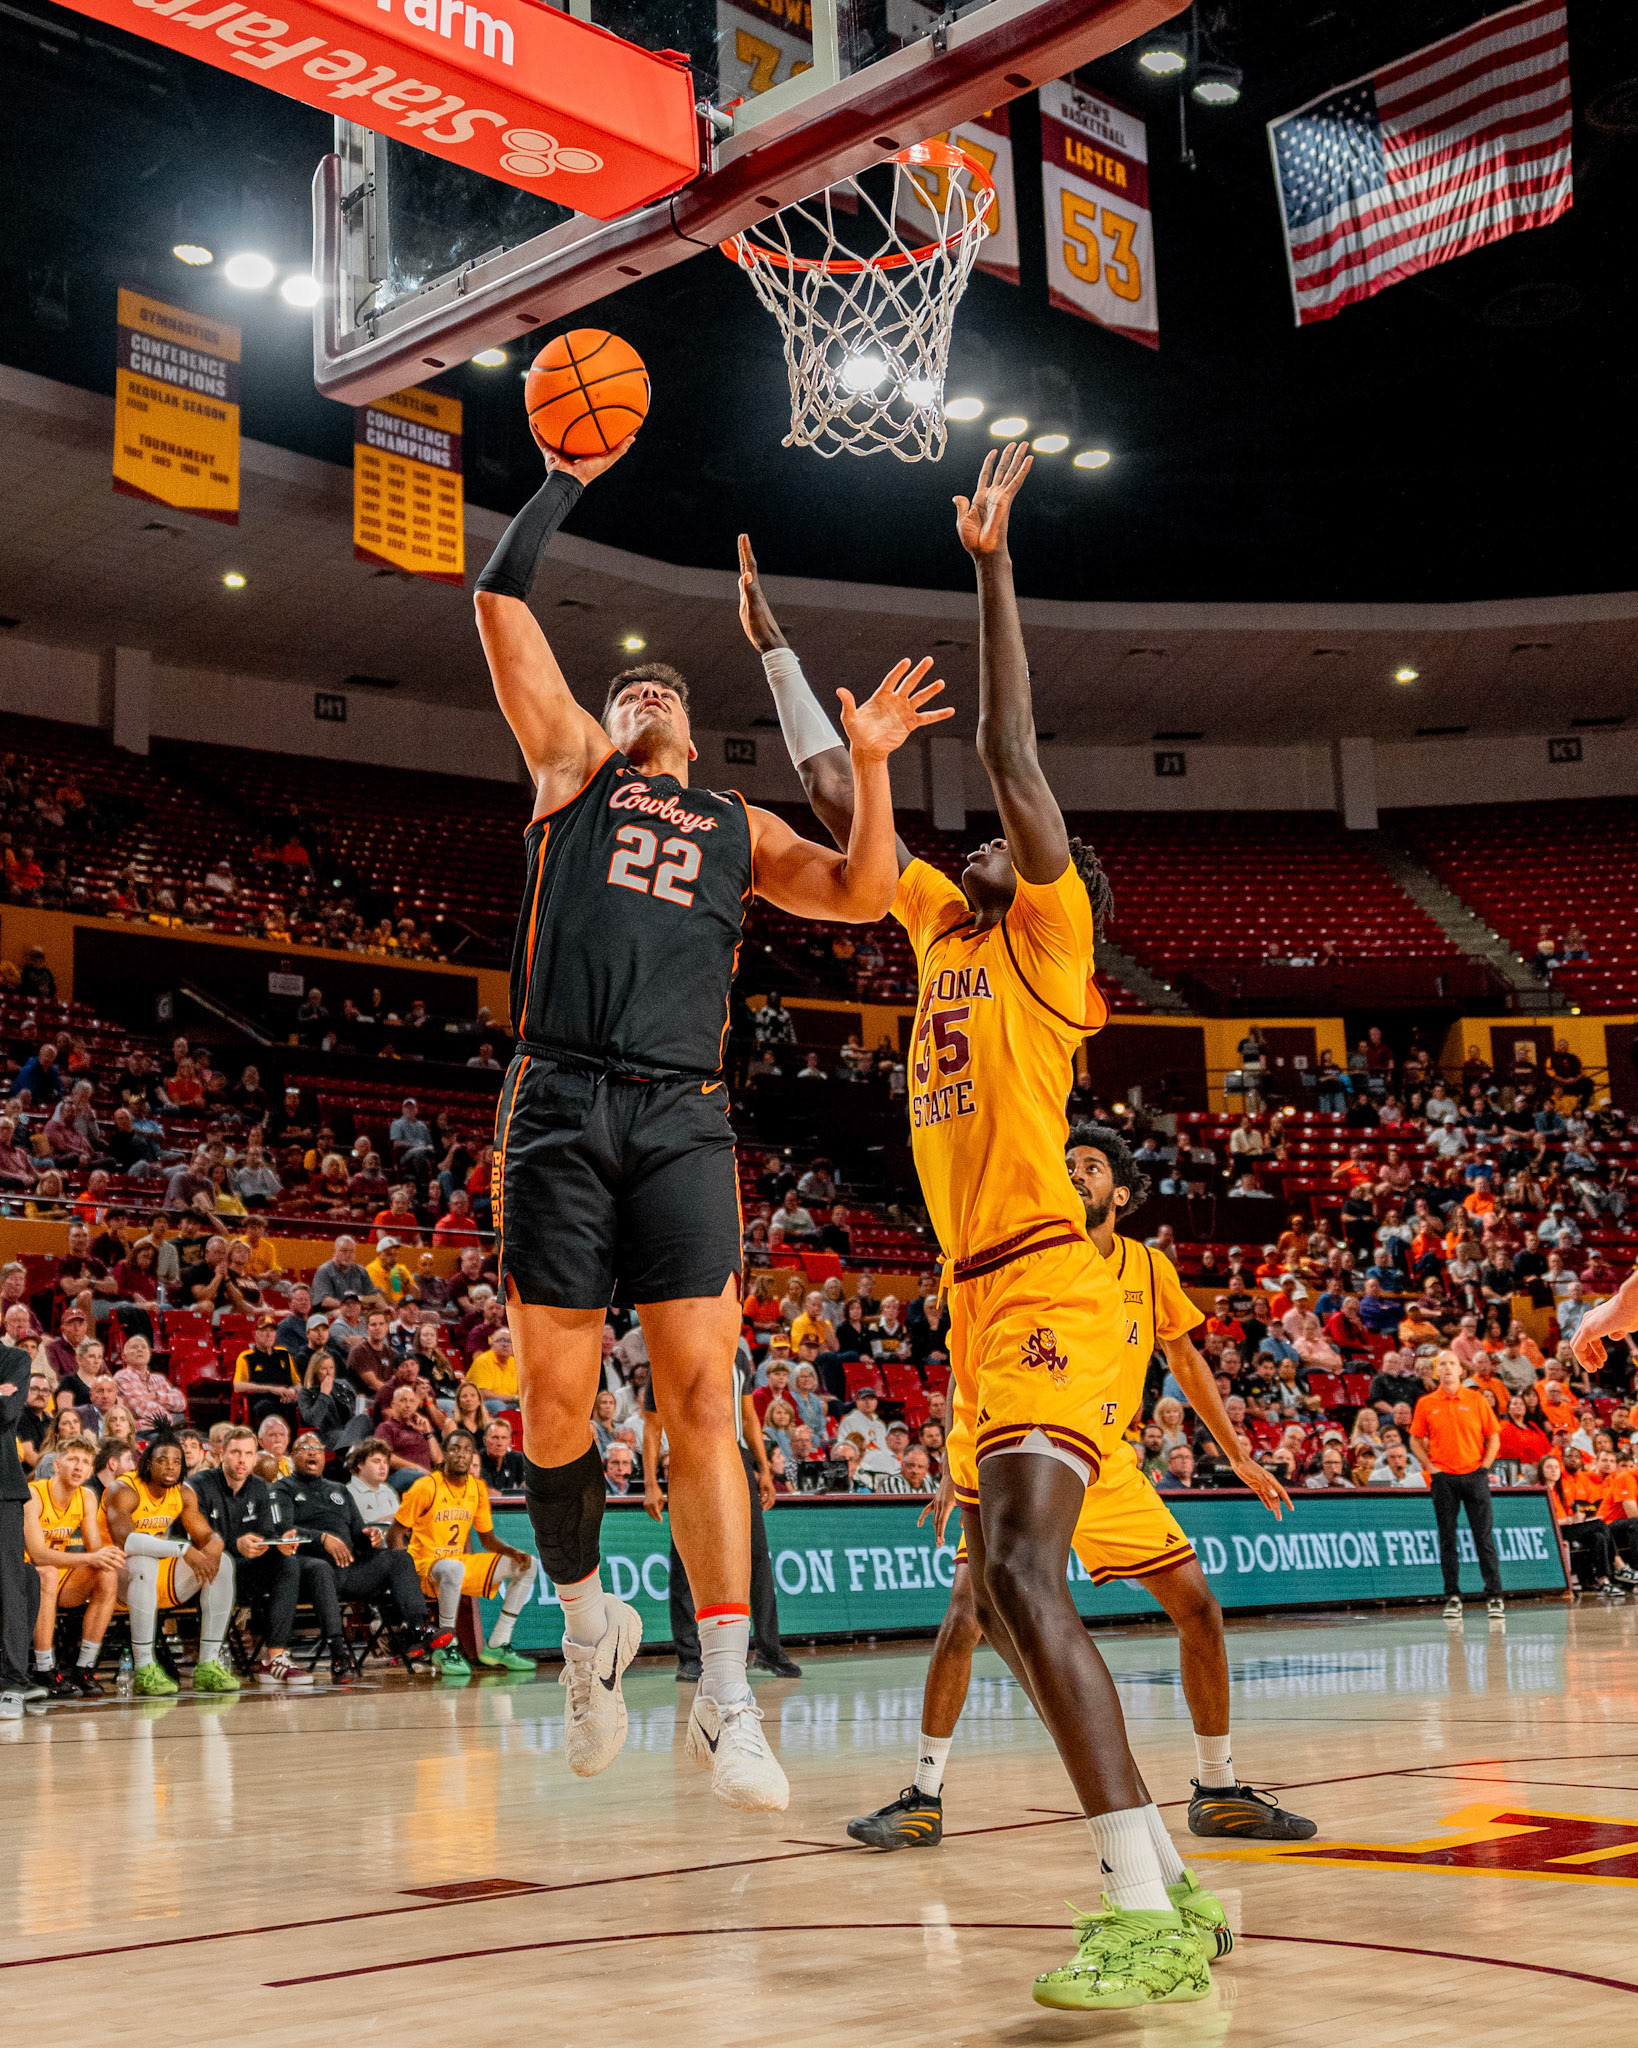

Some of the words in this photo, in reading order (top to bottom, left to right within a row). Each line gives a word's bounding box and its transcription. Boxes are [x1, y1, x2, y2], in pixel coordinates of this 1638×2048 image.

[377, 0, 514, 66] arm
[1061, 103, 1126, 148] BASKETBALL
[1064, 136, 1127, 188] LISTER
[1061, 187, 1143, 302] 53
[129, 352, 226, 397] CHAMPIONS
[131, 333, 226, 379] CONFERENCE
[128, 381, 179, 407] REGULAR
[181, 398, 227, 422] SEASON
[139, 433, 215, 466] TOURNAMENT
[366, 409, 450, 450] CONFERENCE
[366, 426, 451, 468] CHAMPIONS
[609, 781, 719, 834] Cowboys
[607, 824, 703, 907] 22
[916, 1006, 972, 1084] 35
[447, 1524, 460, 1546] 2
[1231, 1530, 1380, 1573] DOMINION
[1490, 1526, 1549, 1561] LINE
